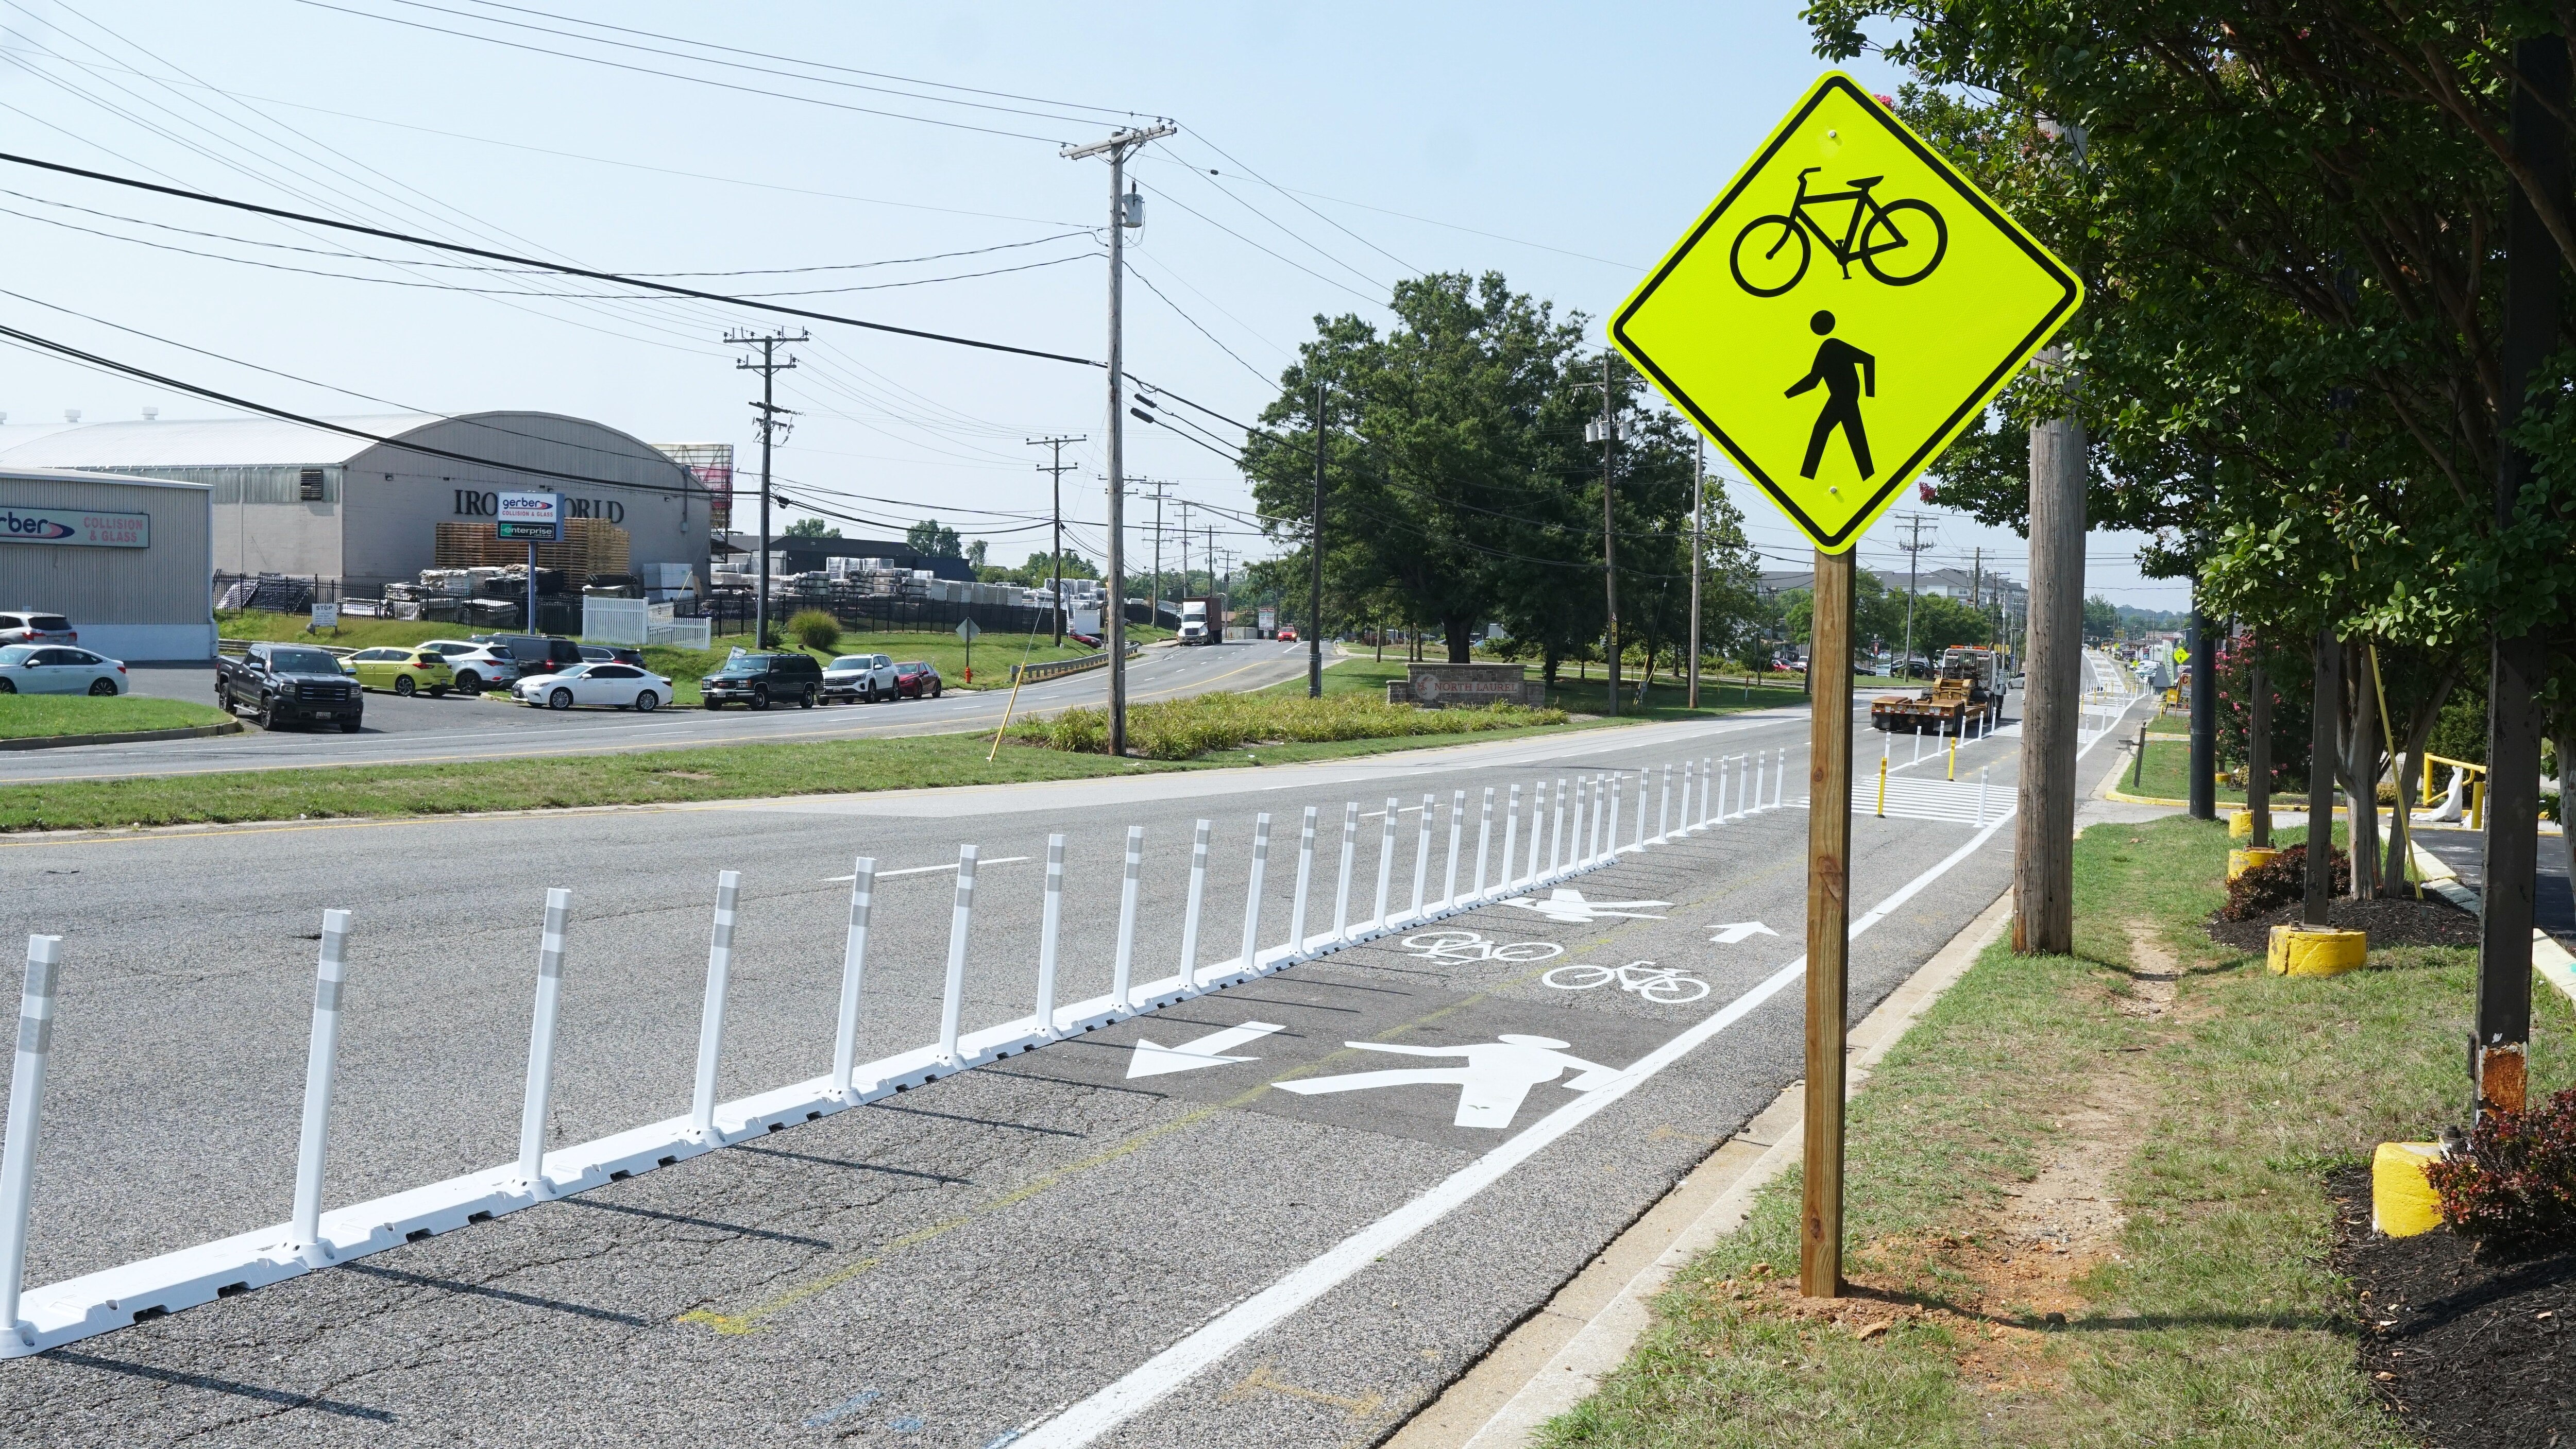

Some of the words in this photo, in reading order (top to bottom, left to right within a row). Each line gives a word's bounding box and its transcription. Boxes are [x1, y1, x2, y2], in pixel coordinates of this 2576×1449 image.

[455, 490, 498, 516] IRO
[564, 498, 624, 523] ORLD
[503, 497, 540, 509] gerber
[83, 517, 143, 530] COLLISION
[90, 530, 97, 541] &
[101, 531, 137, 542] GLASS
[503, 527, 552, 535] enterprise
[1434, 683, 1472, 691] NORTH
[1477, 683, 1517, 692] LAUREL
